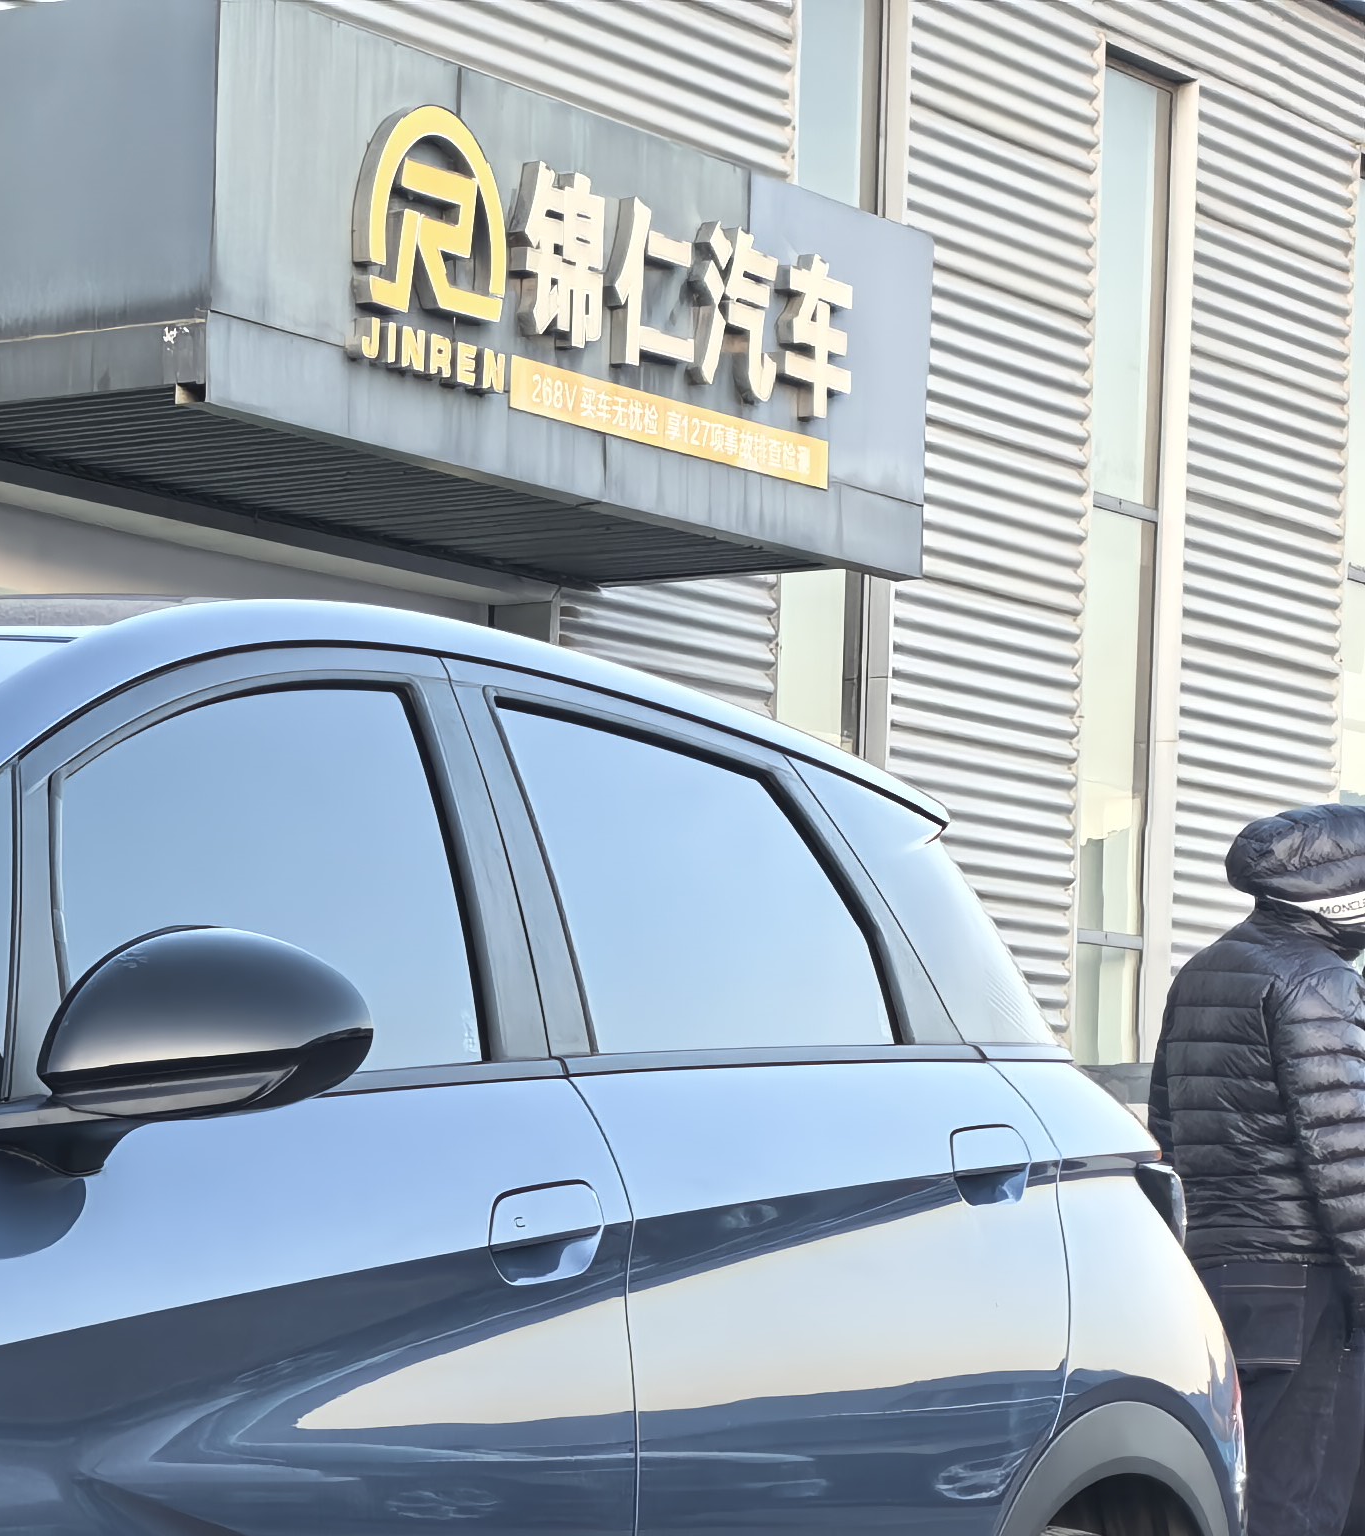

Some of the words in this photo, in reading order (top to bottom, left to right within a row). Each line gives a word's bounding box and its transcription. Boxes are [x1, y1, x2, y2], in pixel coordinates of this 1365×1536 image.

[358, 316, 506, 394] JINREN
[510, 159, 853, 421] 锦仁汽车
